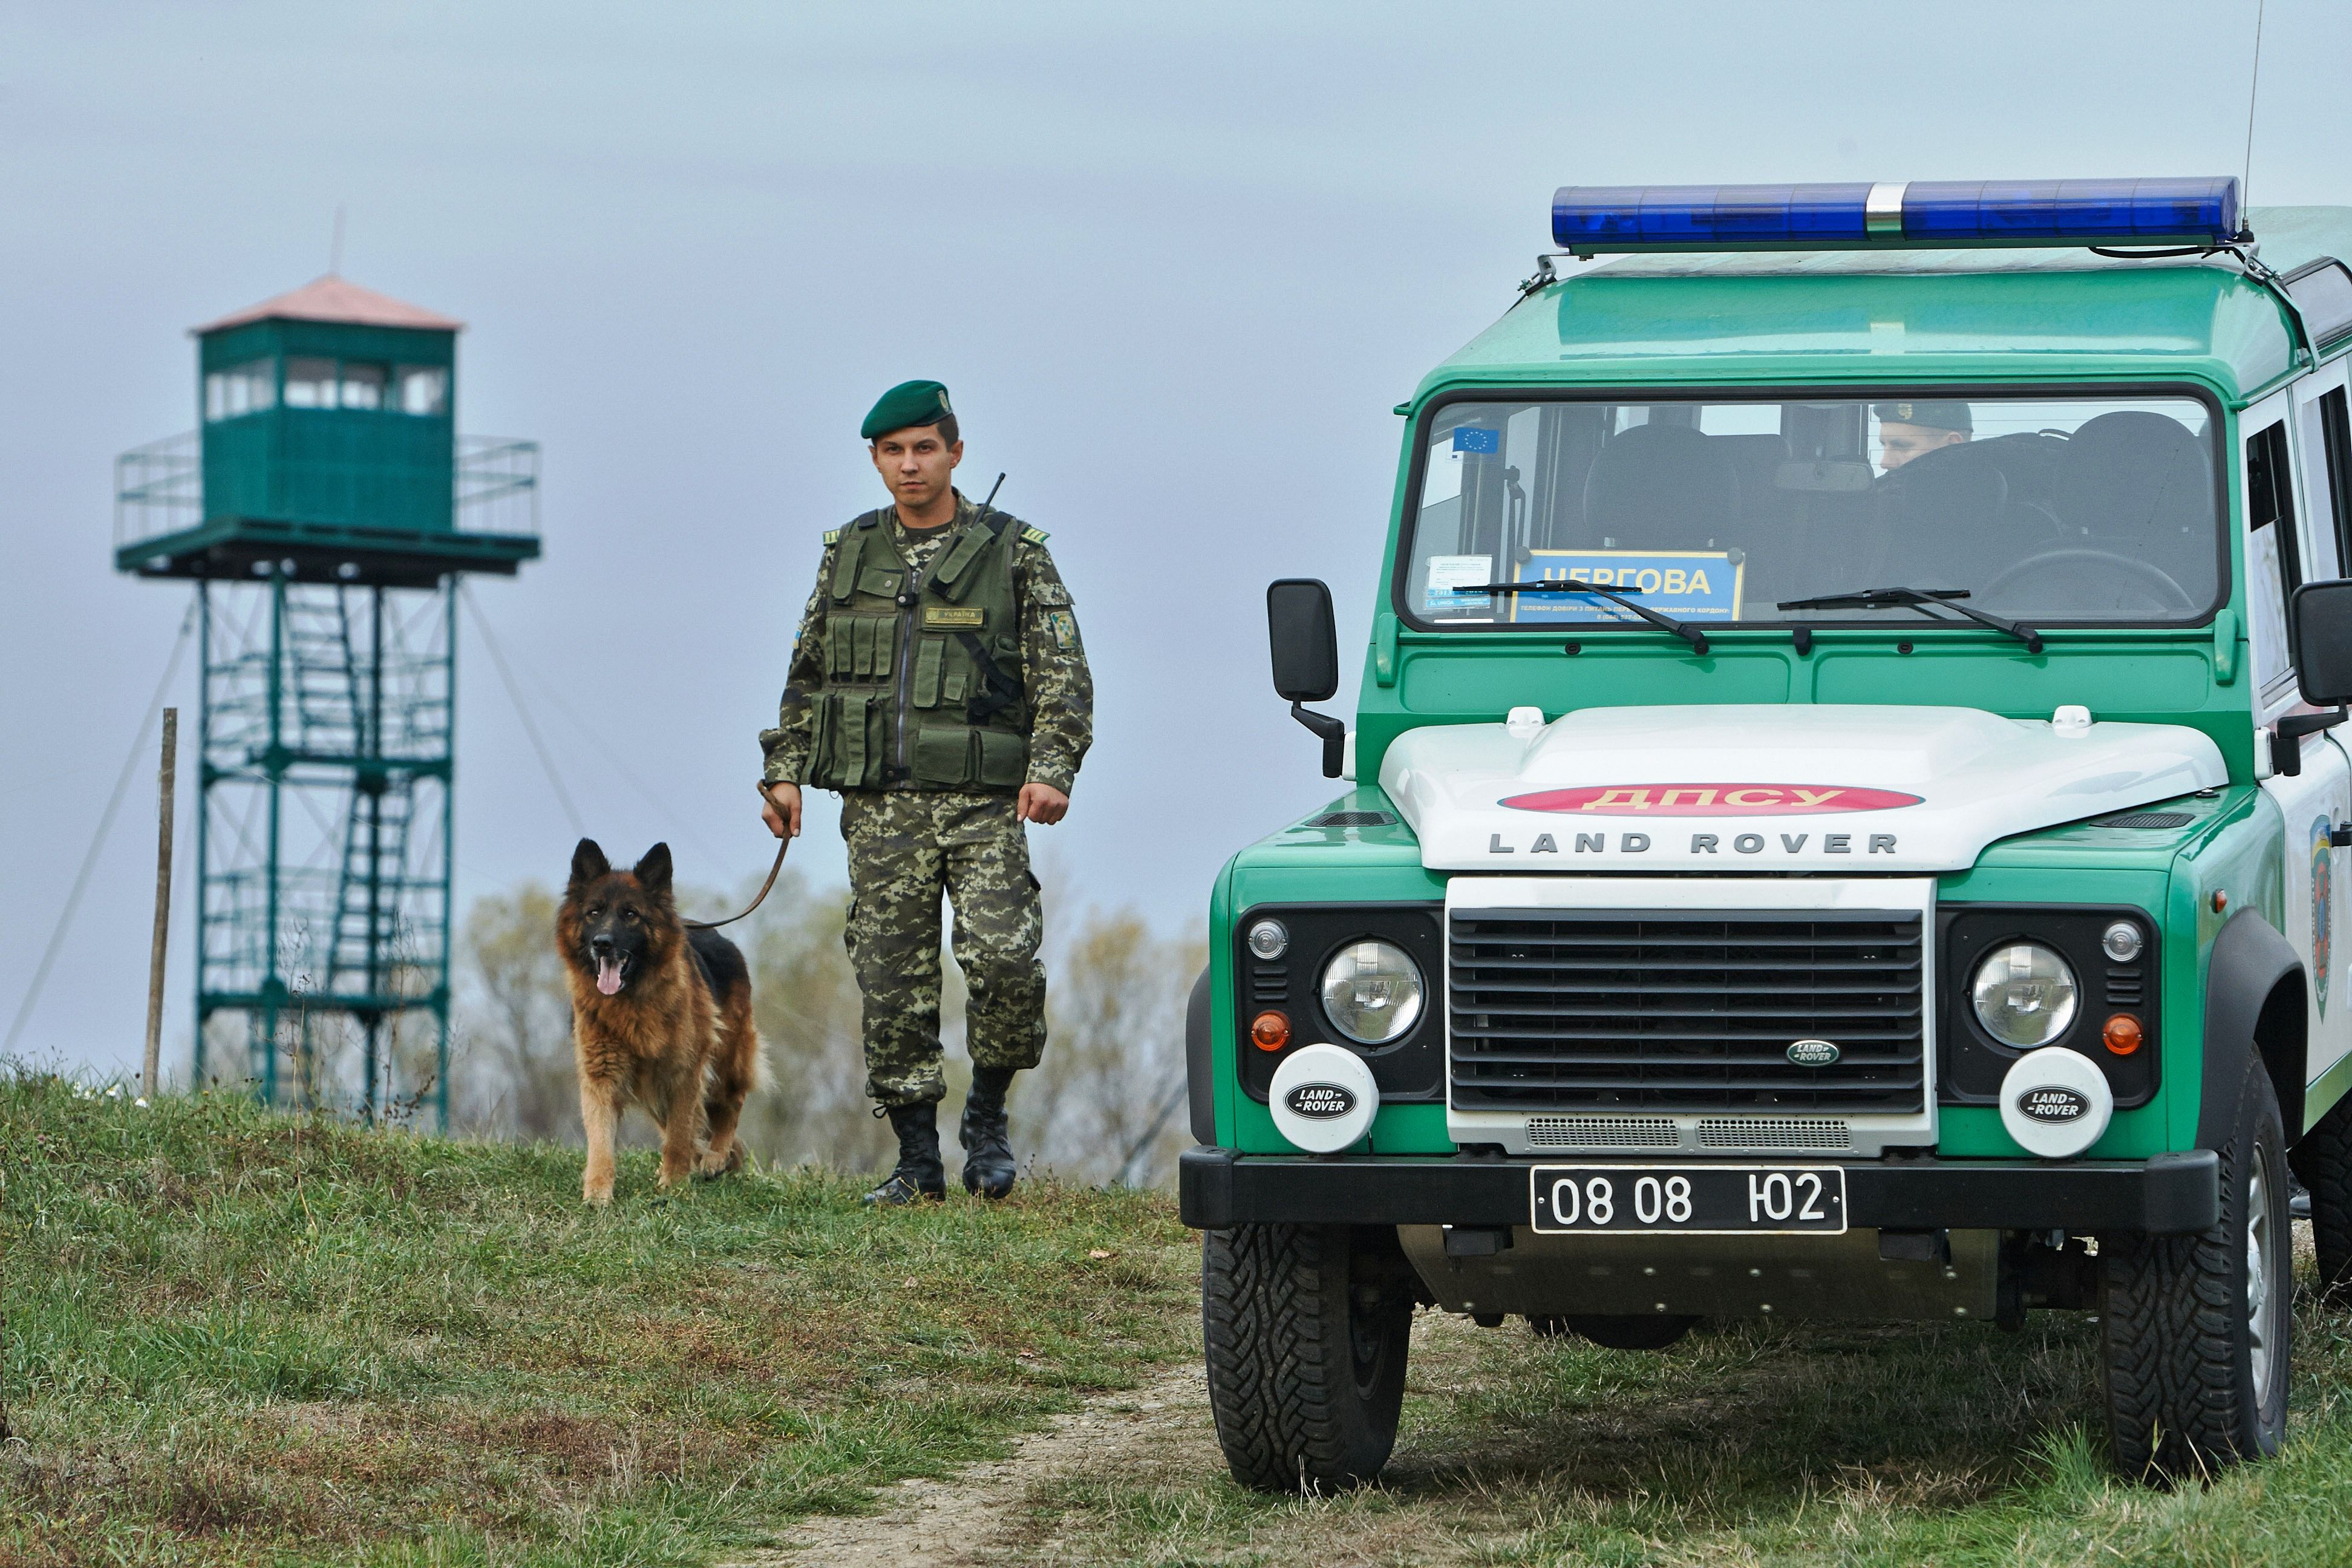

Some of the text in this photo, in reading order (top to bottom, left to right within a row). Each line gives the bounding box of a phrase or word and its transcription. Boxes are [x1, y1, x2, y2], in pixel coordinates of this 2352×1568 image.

[1581, 789, 1846, 810] ДПСУ
[1489, 832, 1898, 854] LAND ROVER
[1797, 1044, 1823, 1053] LAND
[1799, 1053, 1832, 1061] ROVER
[1299, 1089, 1334, 1100] LAND
[2031, 1093, 2068, 1104] LAND
[1302, 1100, 1345, 1111] ROVER
[2034, 1104, 2079, 1116] ROVER
[1552, 1177, 1614, 1225] 08
[1635, 1175, 1692, 1224] 08
